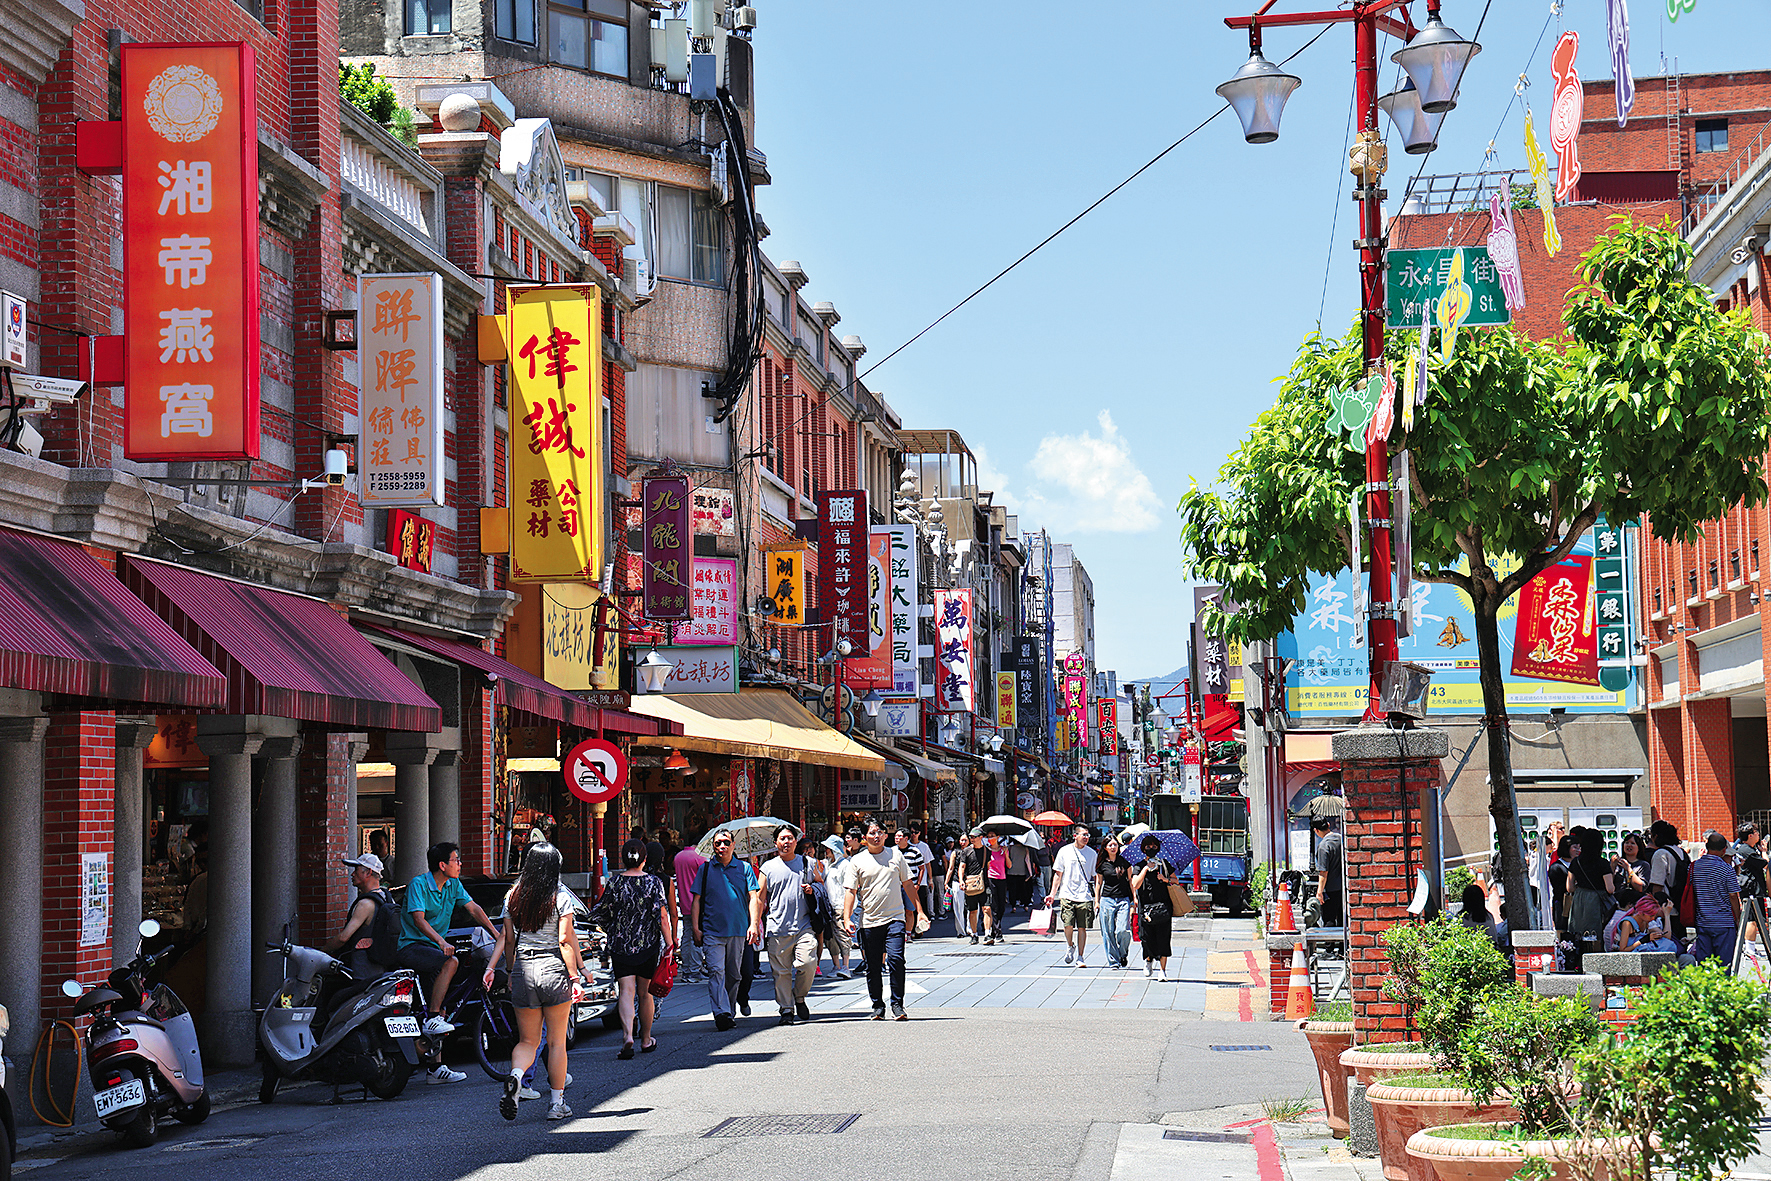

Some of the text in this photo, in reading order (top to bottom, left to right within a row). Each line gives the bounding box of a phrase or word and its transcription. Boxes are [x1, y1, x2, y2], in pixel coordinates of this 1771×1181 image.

[158, 160, 214, 438] 湘帝燕窩
[1398, 257, 1502, 289] 永昌街
[1480, 294, 1497, 312] St.
[371, 288, 422, 404] 聯暉
[518, 326, 586, 459] 偉誠
[400, 405, 426, 466] 佛具
[370, 472, 426, 481] T 2558-5959
[378, 482, 426, 491] 2559-2289
[526, 478, 552, 539] 藥材
[556, 478, 582, 538] 公司
[834, 529, 851, 583] 福來許
[1598, 530, 1623, 655] 第一銀行
[836, 598, 850, 644] 珈琲
[939, 598, 969, 702] 萬安堂
[578, 694, 625, 705] 城隍廟
[1000, 693, 1013, 726] 聯通
[1100, 701, 1116, 753] 百安堂
[561, 737, 578, 829] かすみ
[1203, 860, 1219, 869] 312
